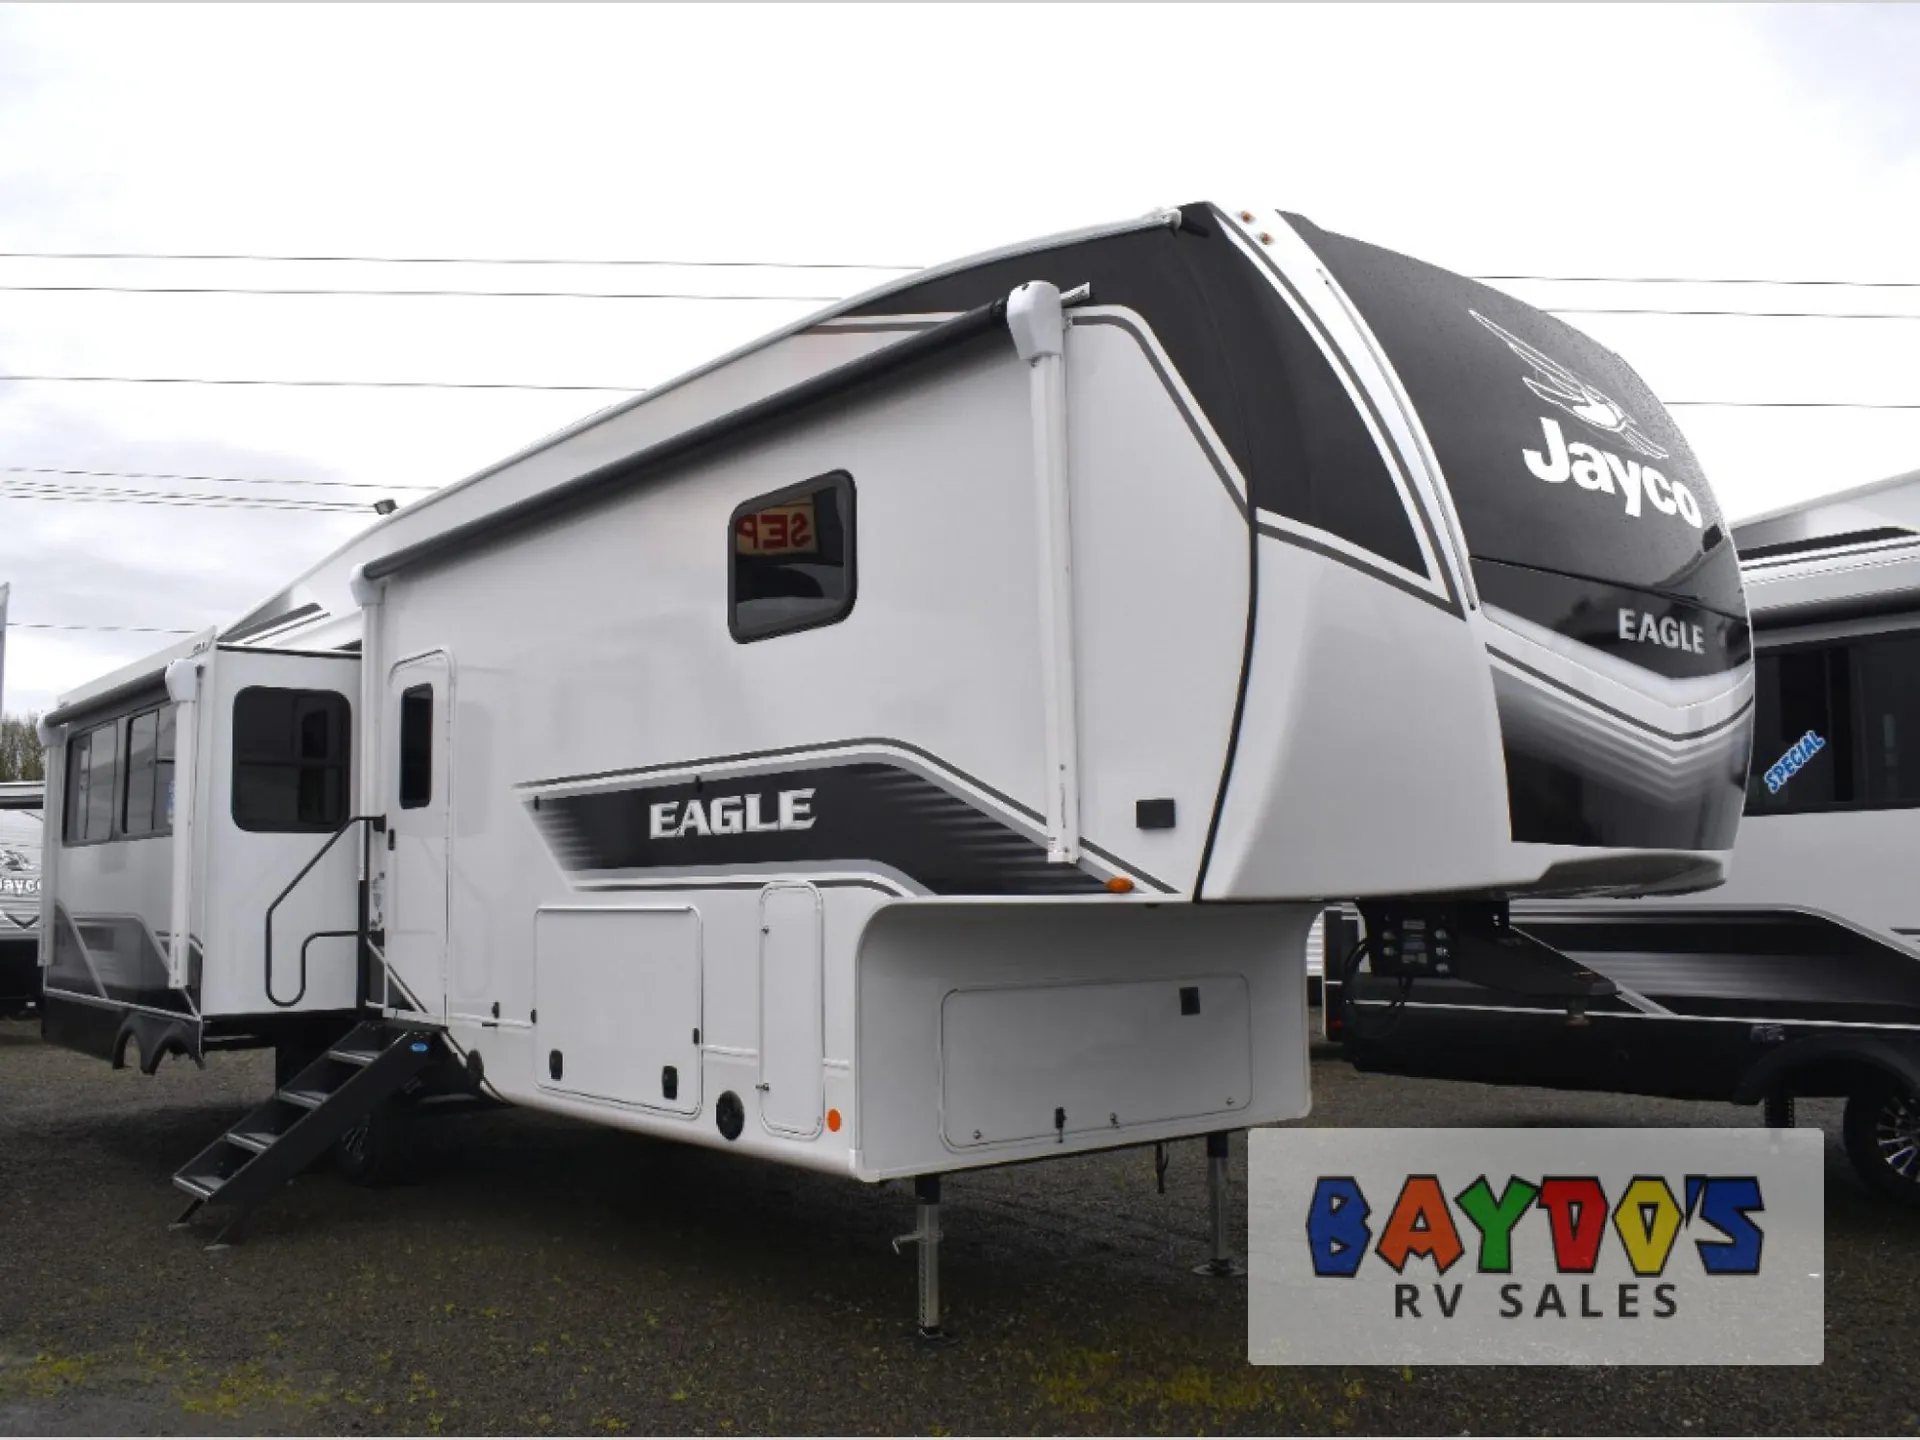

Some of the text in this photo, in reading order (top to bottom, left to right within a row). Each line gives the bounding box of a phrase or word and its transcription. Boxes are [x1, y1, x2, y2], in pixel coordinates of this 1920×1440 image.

[1522, 416, 1703, 529] Jayco
[1618, 608, 1706, 654] EAGLE
[1764, 730, 1826, 794] SPECIAL
[649, 788, 817, 839] EAGLE
